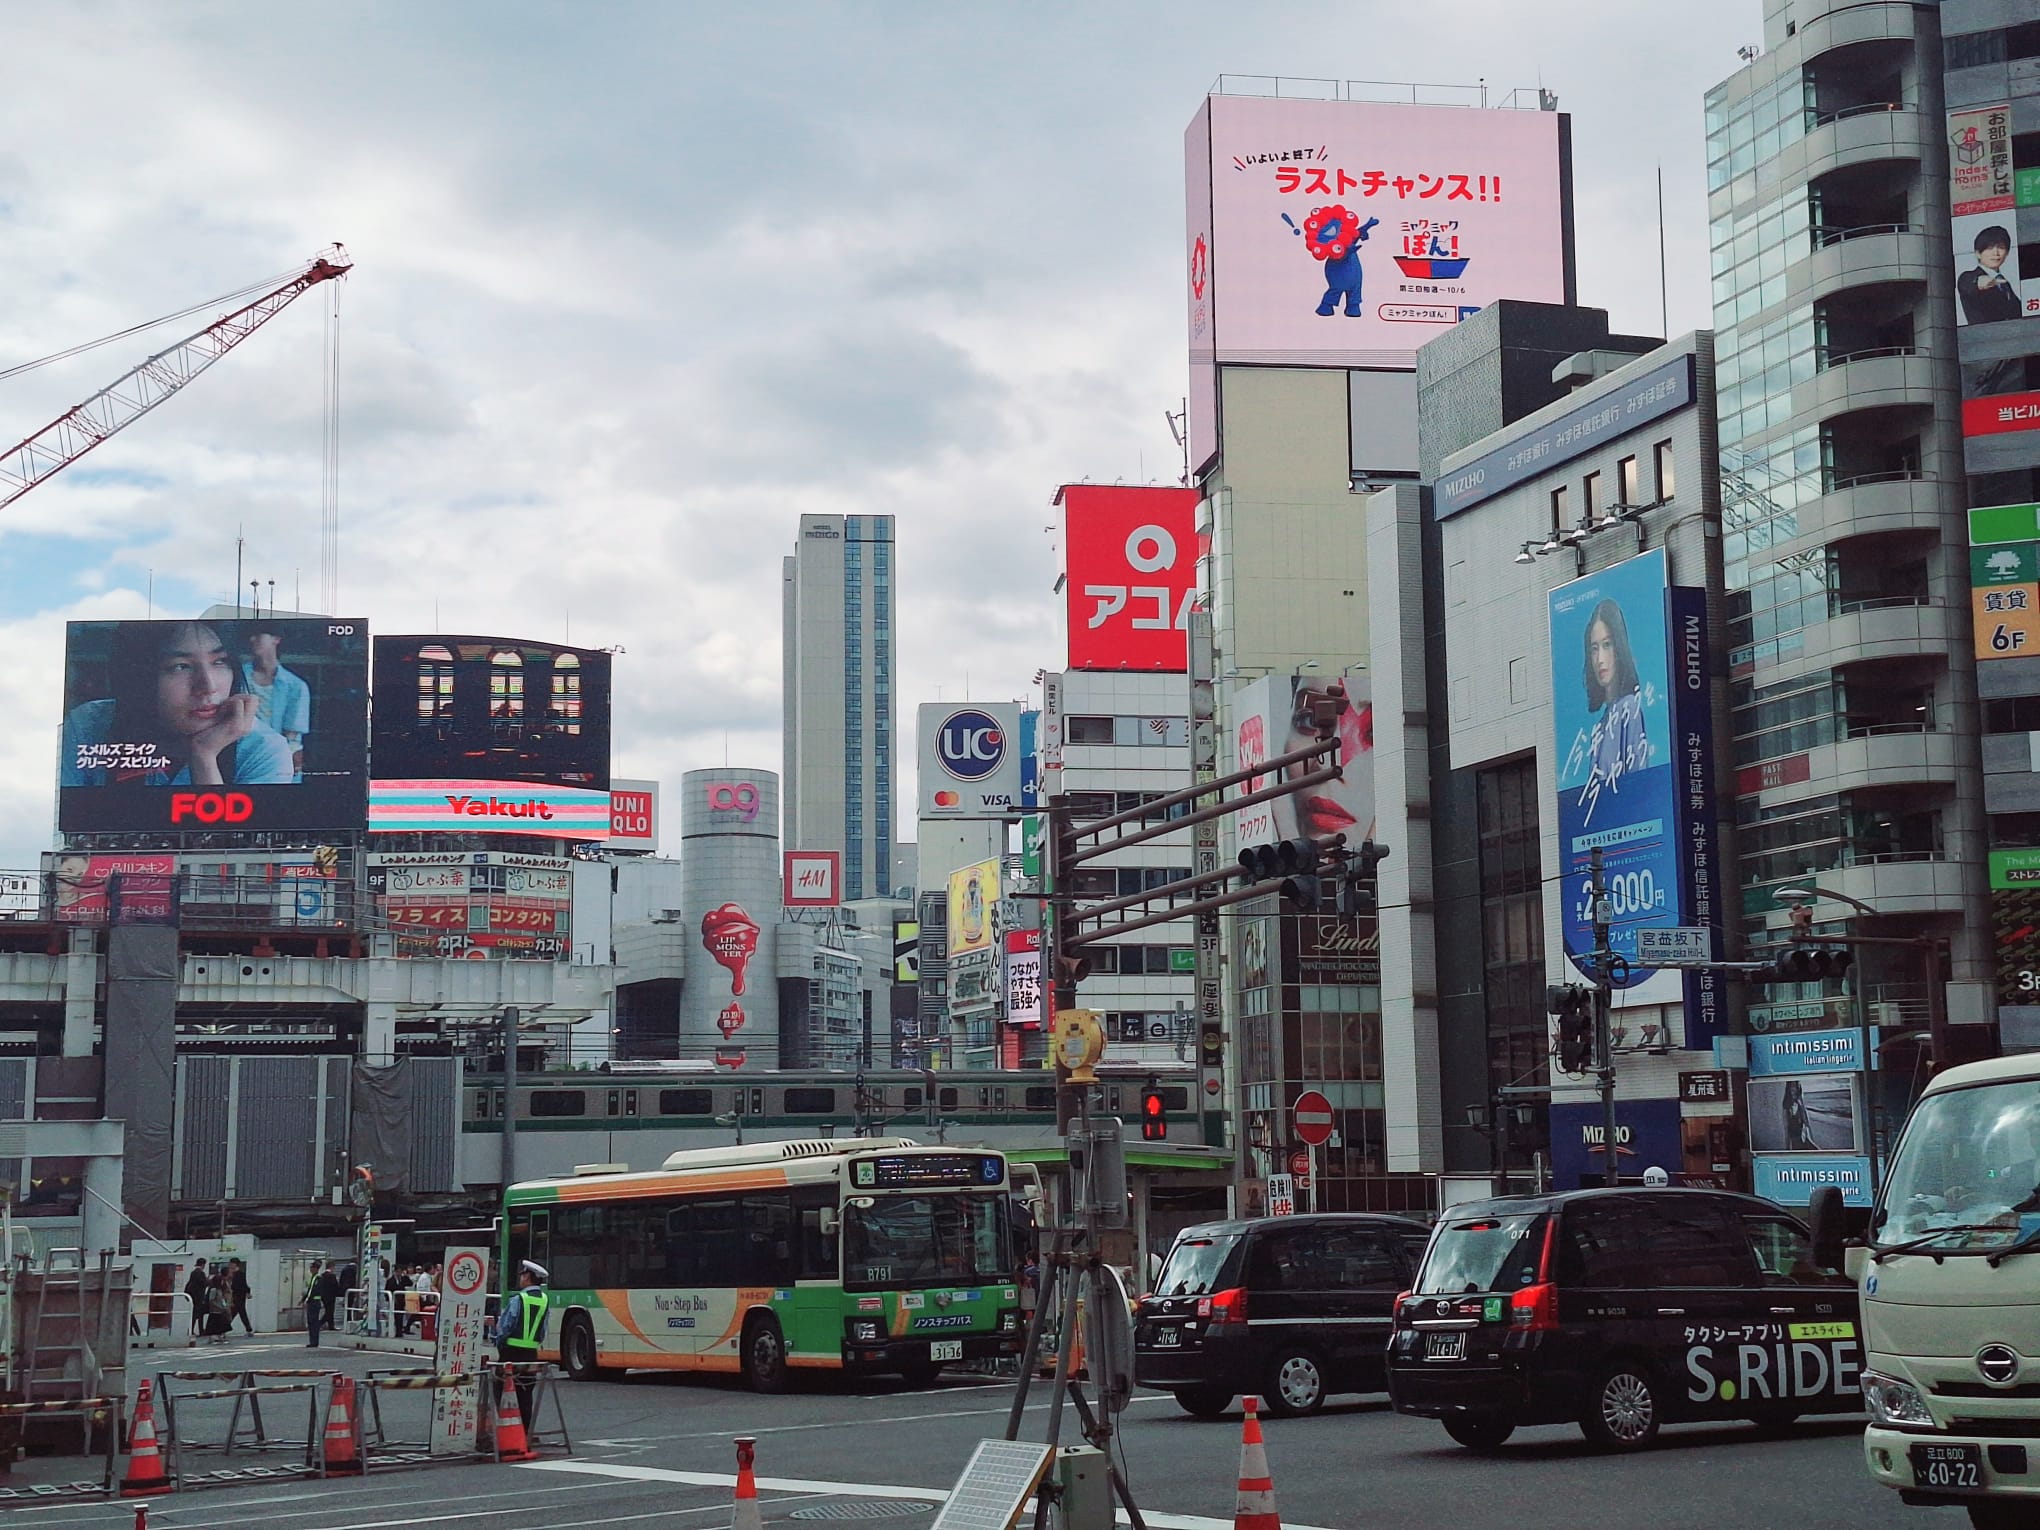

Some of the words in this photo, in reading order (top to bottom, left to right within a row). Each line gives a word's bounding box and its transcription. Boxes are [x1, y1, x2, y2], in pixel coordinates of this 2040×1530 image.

[1988, 112, 2010, 195] お部屋探しは
[1275, 166, 1502, 202] ラストチャンス!!
[1400, 219, 1458, 232] ミャクミャク
[1403, 231, 1459, 258] ぽん!
[1444, 468, 1485, 500] MIZUHO
[1555, 404, 1621, 448] みずほ信託銀行
[1625, 376, 1678, 415] みずほ証券
[1984, 591, 2026, 612] 賃貸
[328, 625, 354, 635] FOD
[1991, 625, 2025, 651] 6F
[1683, 614, 1701, 691] MIZUHO
[77, 744, 120, 756] スメルズ
[123, 743, 157, 755] ライク
[76, 757, 119, 769] グリーン
[171, 793, 254, 824] FOD
[445, 795, 554, 820] Yakult
[613, 796, 645, 813] UNI
[704, 783, 760, 822] 109
[982, 795, 1012, 806] VISA
[613, 815, 648, 833] QLO
[2005, 857, 2025, 866] The
[369, 875, 386, 886] 9F
[490, 908, 553, 925] コンタクト
[716, 943, 746, 951] MONS
[720, 936, 735, 944] LIP
[1201, 937, 1217, 950] 3F
[1642, 932, 1704, 946] 宮益坂下
[1771, 1037, 1853, 1055] intimissimi
[1777, 1168, 1860, 1183] intimissimi
[1269, 1180, 1292, 1198] 危険!!
[1510, 1229, 1531, 1240] 071
[693, 1295, 708, 1311] Bus
[914, 1315, 973, 1328] ノンステップバス
[1683, 1324, 1783, 1343] タクシーアプリ
[1801, 1325, 1844, 1336] エスライド
[935, 1346, 961, 1358] 31-36
[1686, 1341, 1860, 1402] S.RIDE
[1928, 1462, 1979, 1487] 60-22
